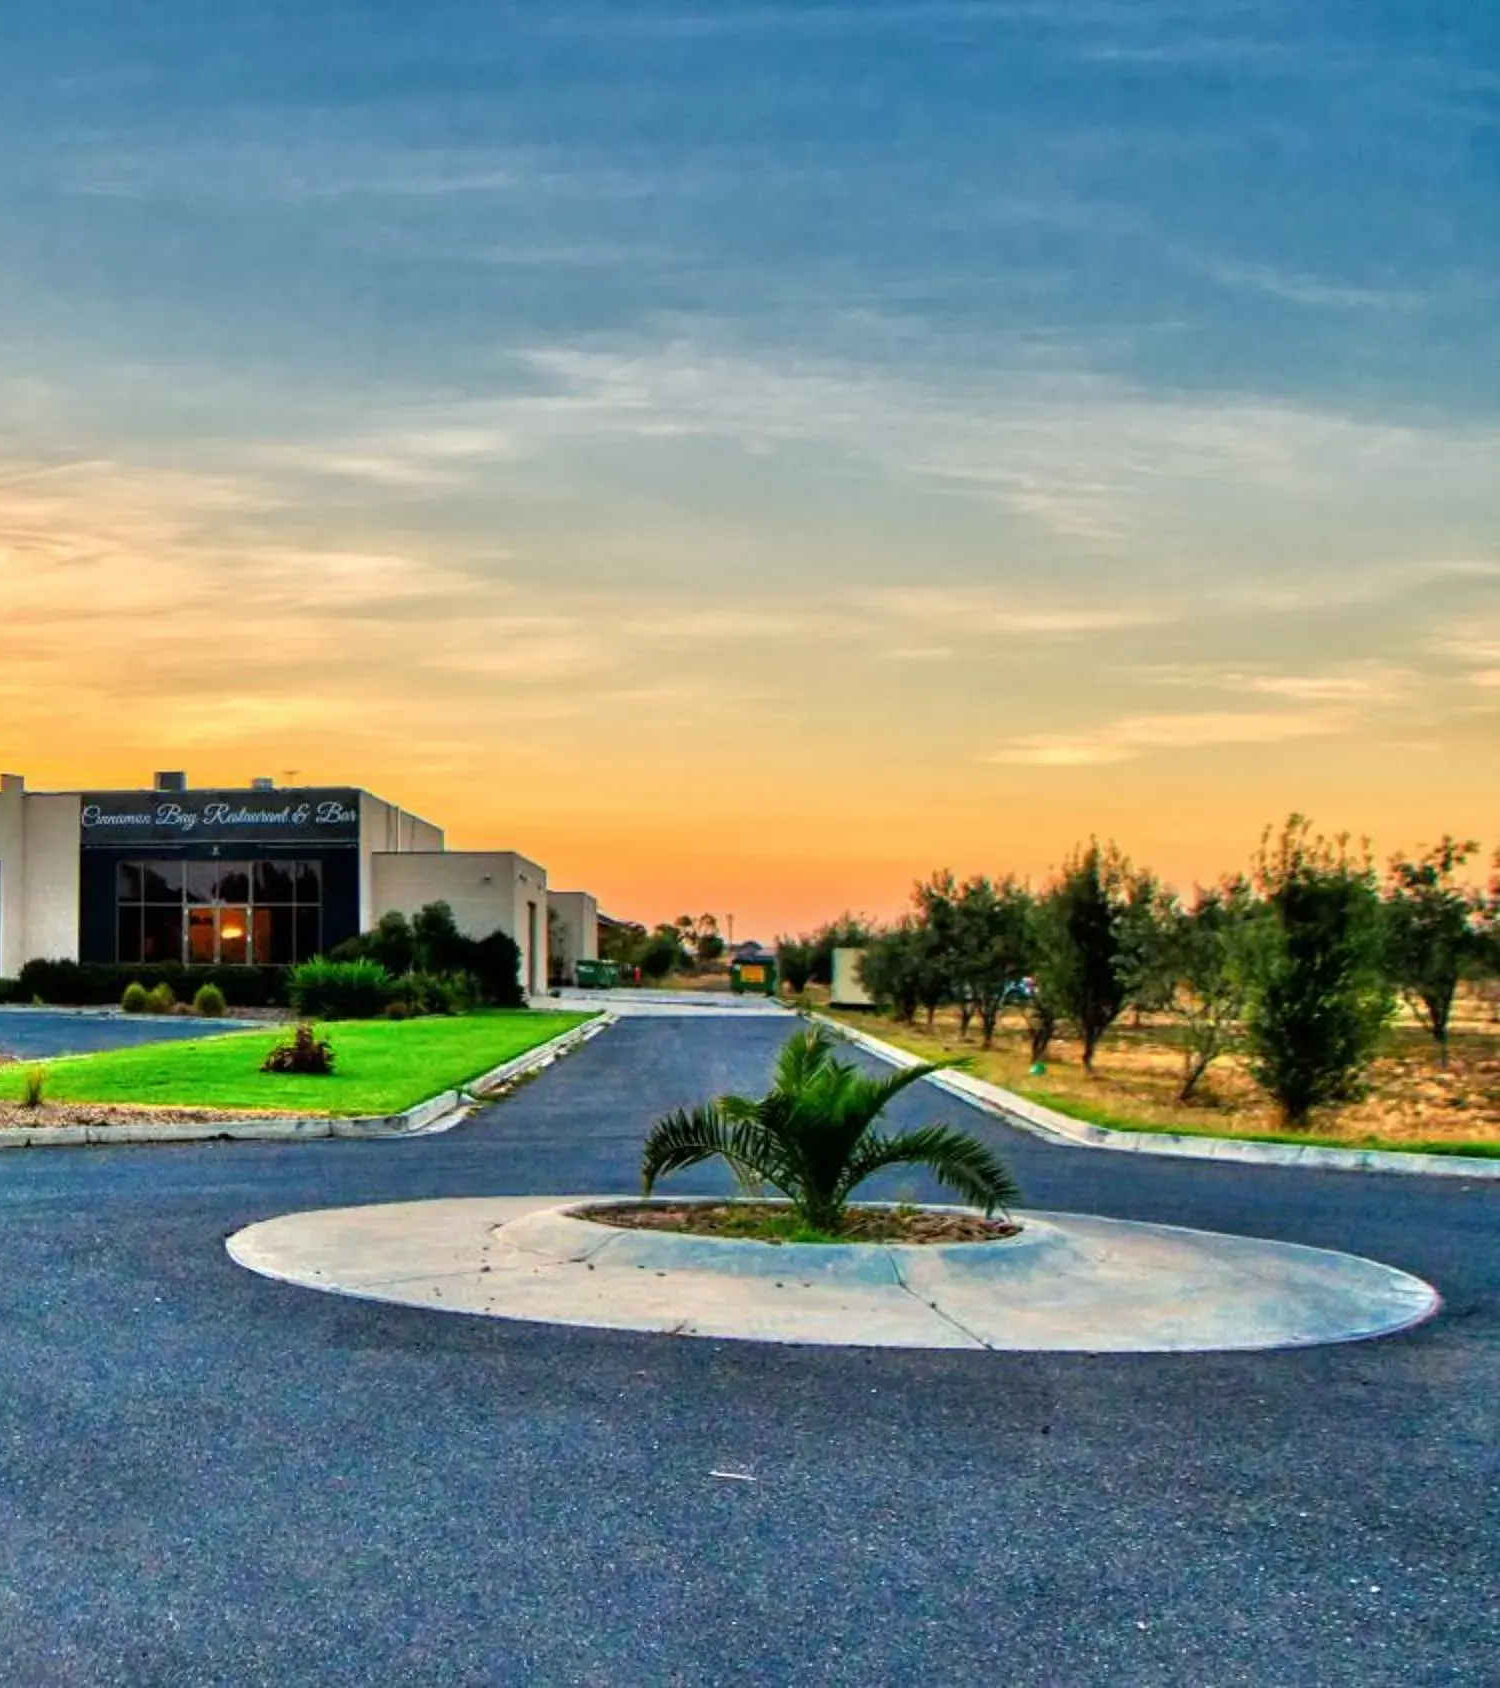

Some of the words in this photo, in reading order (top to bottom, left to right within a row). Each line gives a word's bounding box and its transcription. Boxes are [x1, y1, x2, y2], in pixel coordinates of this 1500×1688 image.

[81, 804, 151, 828] Cinnamon
[155, 802, 198, 832] Bay
[202, 803, 290, 825] Restaurant
[291, 803, 311, 824] &
[315, 801, 357, 824] Bar
